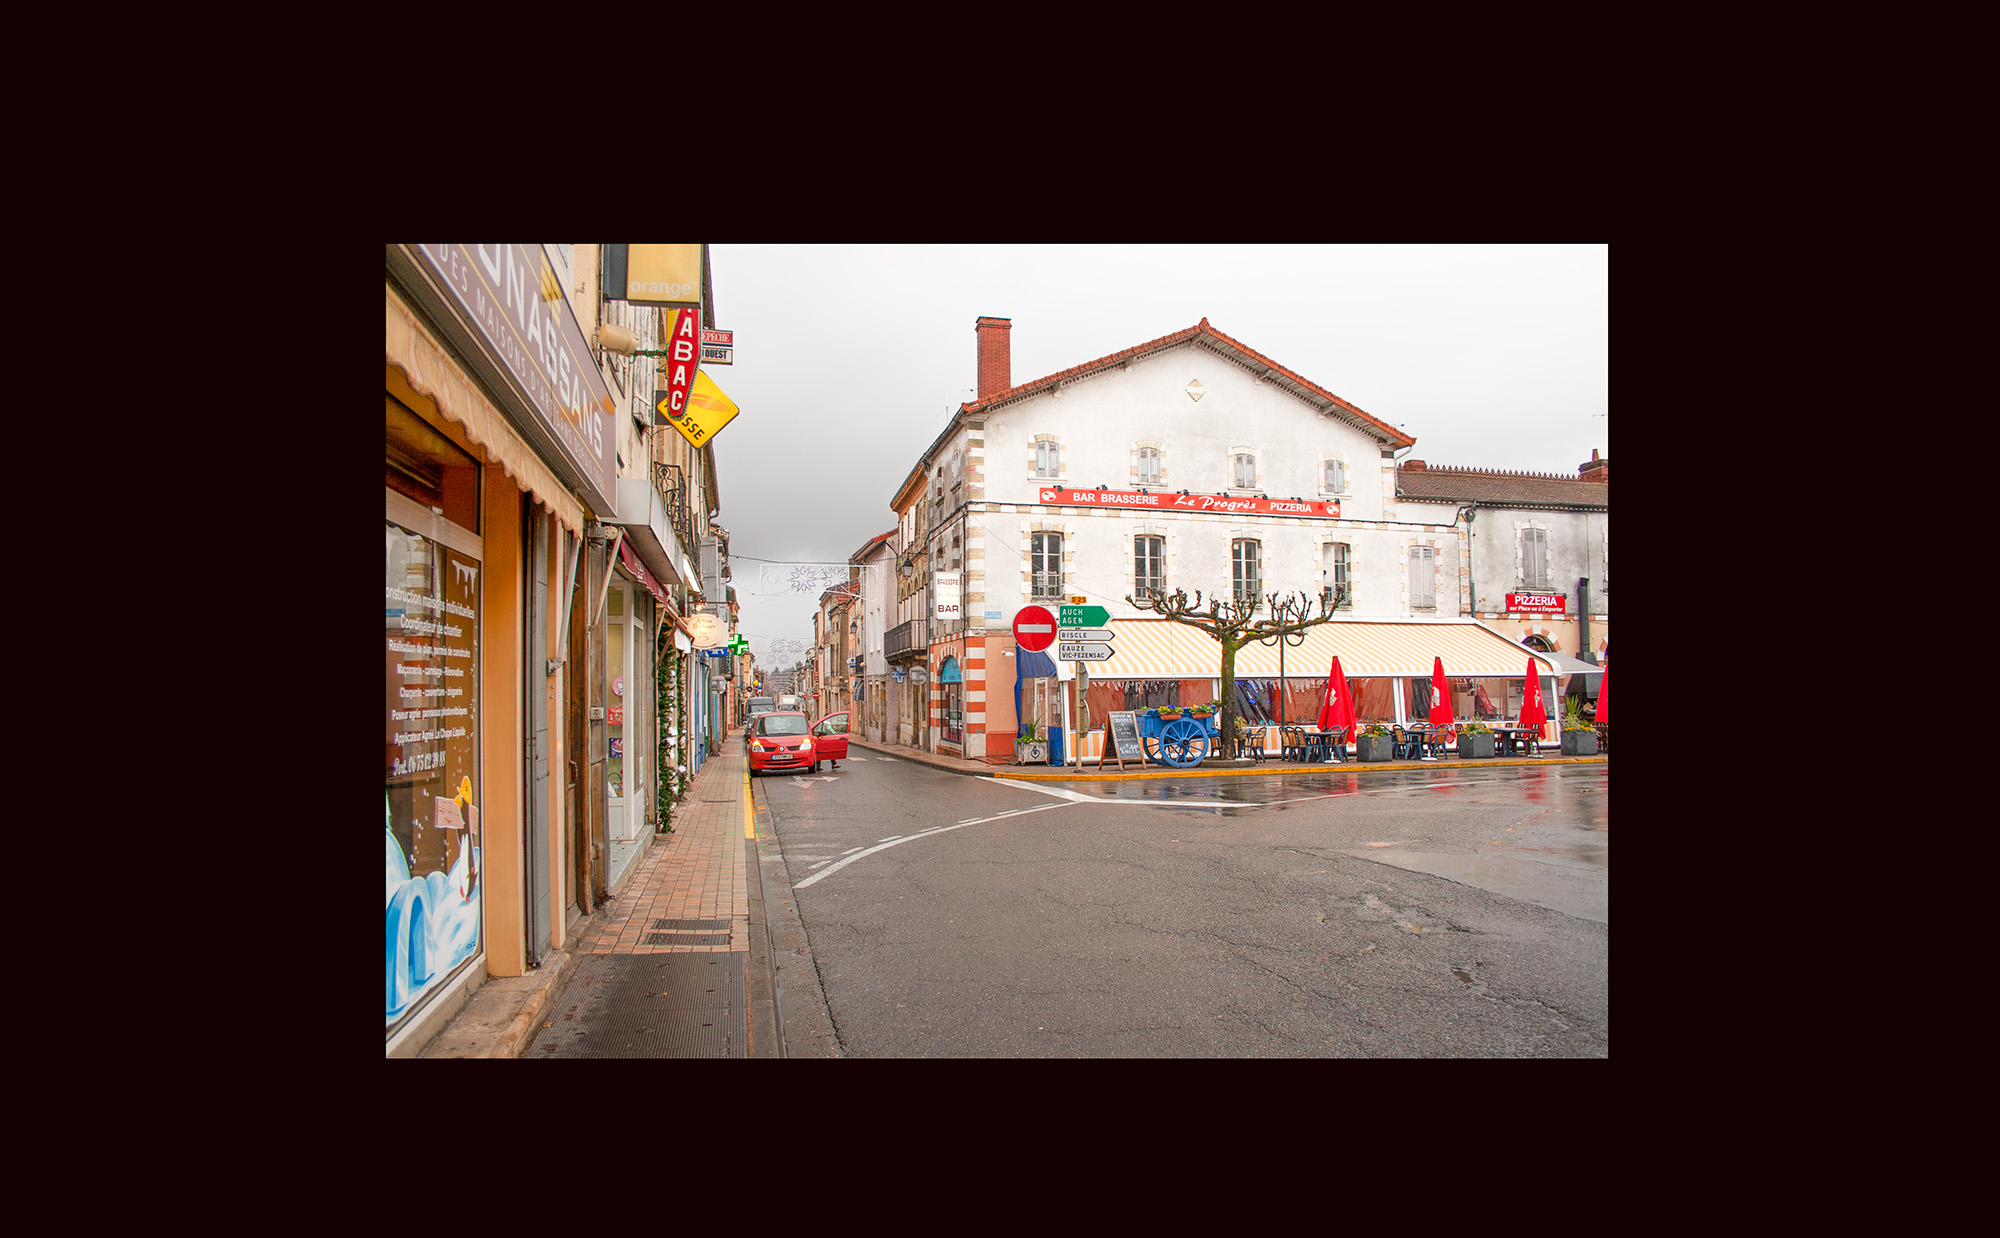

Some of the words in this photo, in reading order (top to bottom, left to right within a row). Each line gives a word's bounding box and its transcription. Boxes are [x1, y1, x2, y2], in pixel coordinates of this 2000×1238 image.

[630, 281, 692, 298] orange
[477, 288, 527, 378] MAISONS
[670, 308, 694, 411] ABAC
[705, 349, 728, 359] OUEST
[1073, 492, 1095, 502] BAR
[1101, 493, 1159, 505] BRASSERIE
[1174, 494, 1196, 507] Le
[1270, 502, 1312, 513] PIZZERIA
[1515, 596, 1557, 606] PIZZERIA
[937, 604, 960, 613] BAR
[1062, 608, 1083, 616] AUCH
